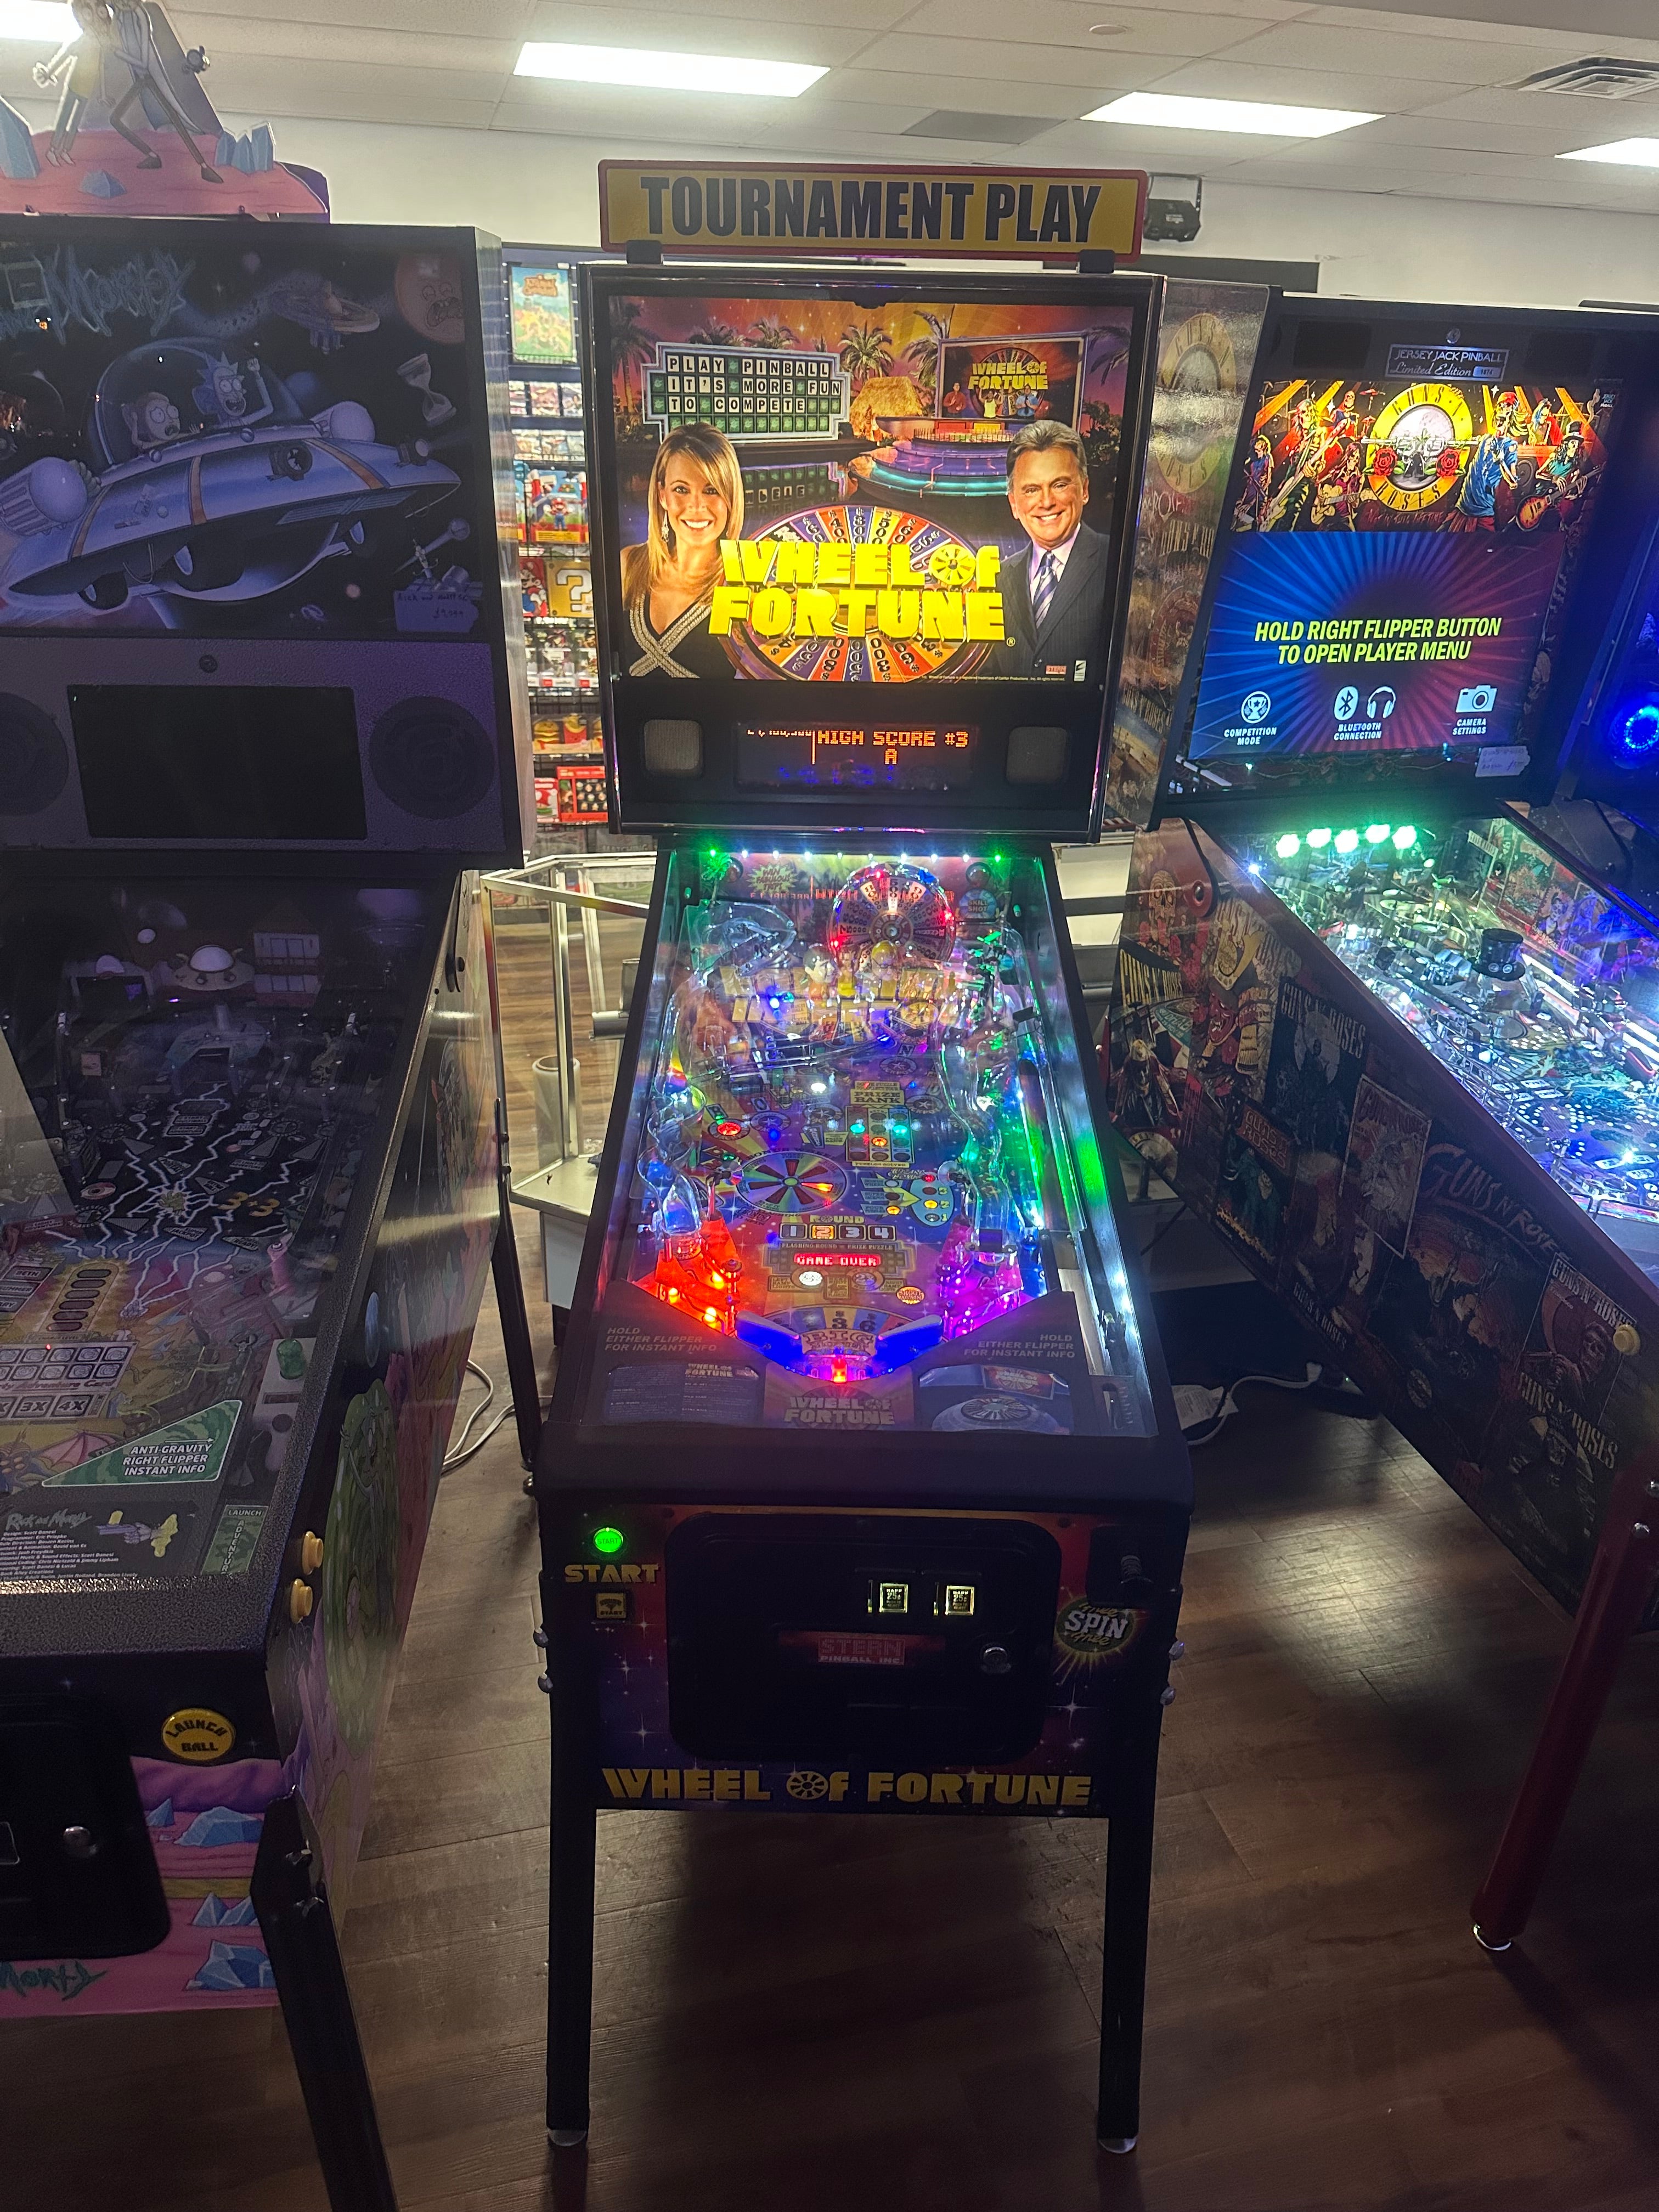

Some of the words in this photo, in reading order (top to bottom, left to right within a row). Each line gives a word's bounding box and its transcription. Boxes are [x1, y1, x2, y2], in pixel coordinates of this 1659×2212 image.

[640, 176, 973, 242] TOURNAMENT
[985, 183, 1101, 243] PLAY
[1394, 349, 1435, 360] JERSEY
[1432, 351, 1459, 362] JACK
[1460, 352, 1503, 363] PINBALL
[669, 358, 723, 371] PLAY
[744, 360, 828, 375] PINBALL
[972, 362, 1026, 375] WHEEL
[1390, 362, 1434, 375] Limited
[1434, 363, 1472, 376] Edition
[672, 378, 723, 391] IT'S
[744, 380, 792, 392] MORE
[809, 383, 840, 395] FUN
[968, 375, 1048, 390] FORTUNE
[672, 398, 695, 410] TO
[716, 399, 804, 411] COMPETE
[1392, 383, 1444, 416] GUNS
[1375, 481, 1442, 511] ROSES
[720, 539, 925, 589] WHEEL
[708, 586, 1005, 642] FORTUNE
[1254, 621, 1305, 642] HOLD
[1307, 619, 1364, 641] RIGHT
[1364, 618, 1434, 640] FLIPPER
[1436, 617, 1502, 637] BUTTON
[1278, 645, 1301, 665] TO
[1304, 643, 1352, 664] OPEN
[1353, 641, 1418, 663] PLAYER
[1420, 640, 1472, 661] MENU
[1337, 722, 1382, 733] BLUETOOTH
[1456, 718, 1487, 728] CAMERA
[1223, 726, 1277, 738] COMPETITION
[1333, 730, 1383, 742] CONNECTION
[1452, 726, 1487, 736] SETTINGS
[817, 731, 864, 745] HIGH
[872, 731, 936, 747] SCORE
[944, 731, 969, 747] #3
[1237, 736, 1261, 746] MODE
[884, 748, 898, 765] A
[1163, 969, 1182, 1002] ROSES
[1329, 1008, 1366, 1059] ROSES
[1243, 1125, 1286, 1169] ROSES
[940, 1200, 950, 1209] 2
[810, 1215, 865, 1224] ROUND
[941, 1213, 948, 1222] 1
[171, 1229, 201, 1239] JACKPOT
[790, 1226, 797, 1237] 1
[815, 1226, 831, 1237] 2
[845, 1227, 860, 1238] 3
[874, 1227, 889, 1238] 4
[797, 1256, 833, 1266] GAME
[839, 1257, 878, 1267] OVER
[1551, 1259, 1581, 1297] GUNS
[803, 1331, 873, 1344] BIG
[685, 1369, 733, 1378] FORTUNE
[19, 1401, 49, 1412] 3X
[58, 1400, 86, 1412] 4X
[789, 1397, 865, 1409] WHEEL
[783, 1409, 895, 1425] FORTUNE
[1518, 1372, 1554, 1413] GUNS
[1572, 1412, 1618, 1469] ROSES
[130, 1443, 213, 1454] ANTI-GRAVITY
[123, 1455, 158, 1465] RIGHT
[160, 1454, 208, 1464] FLIPPER
[124, 1465, 177, 1476] INSTANT
[177, 1464, 206, 1474] INFO
[564, 1564, 660, 1583] START
[1064, 1610, 1129, 1639] SPIN
[822, 1638, 902, 1657] STERN
[165, 1719, 228, 1738] LAUNCH
[180, 1742, 218, 1752] BALL
[601, 1768, 771, 1801] WHEEL
[867, 1771, 1093, 1807] FORTUNE
